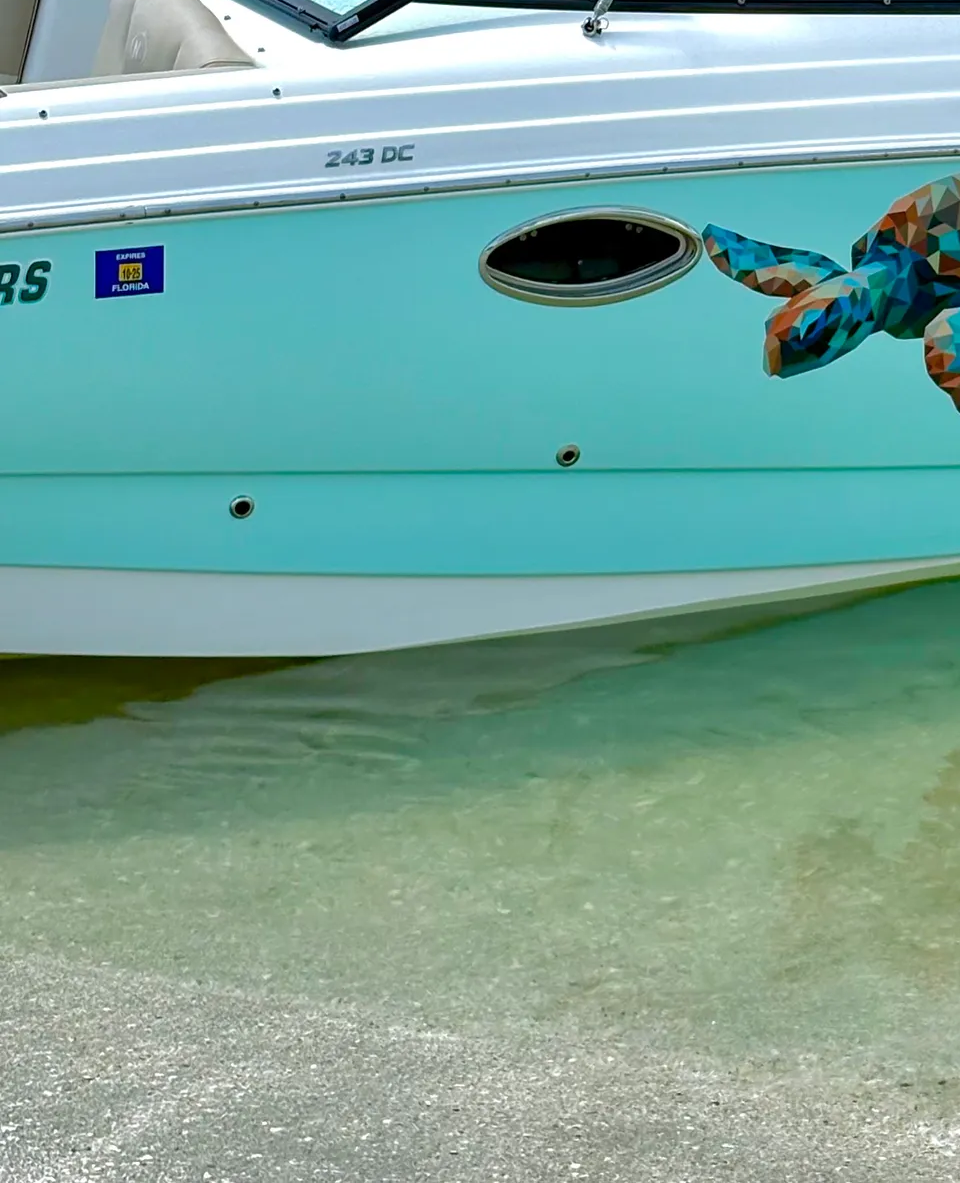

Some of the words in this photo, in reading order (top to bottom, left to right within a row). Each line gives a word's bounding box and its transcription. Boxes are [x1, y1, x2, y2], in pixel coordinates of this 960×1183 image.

[325, 148, 374, 168] 243
[381, 144, 415, 163] DC
[116, 252, 146, 260] EXPIRES
[112, 282, 150, 292] FLORIDA
